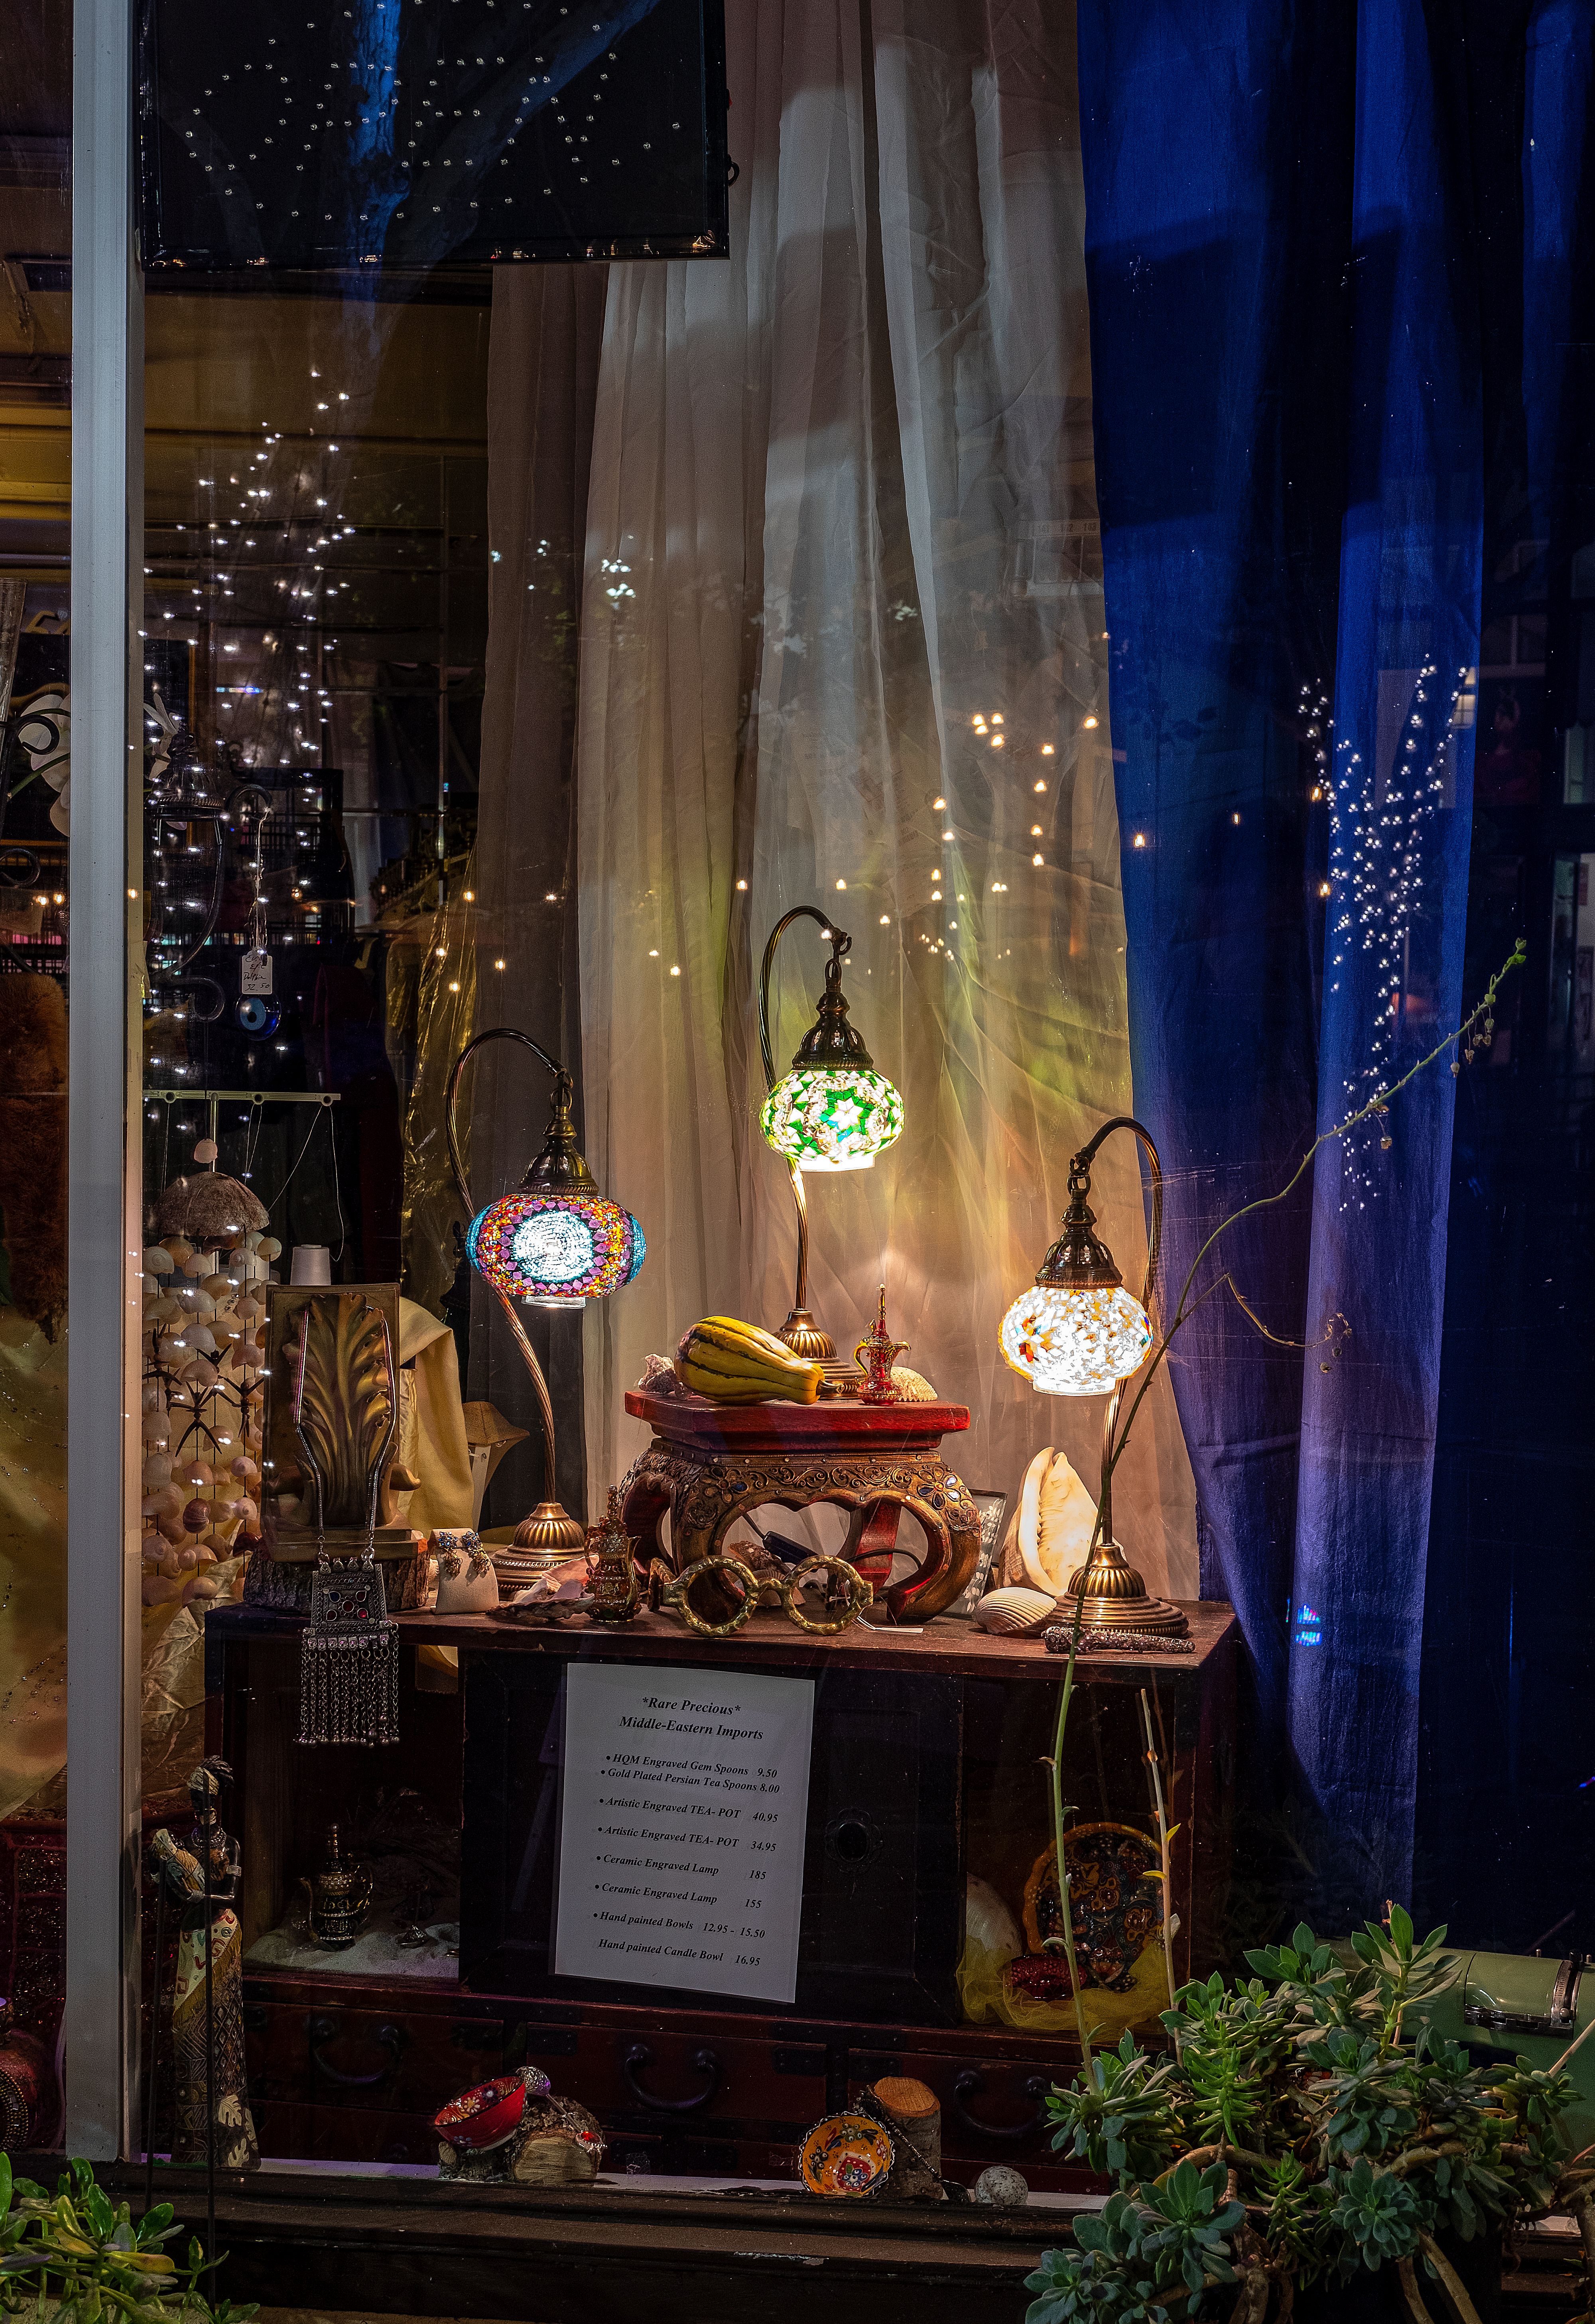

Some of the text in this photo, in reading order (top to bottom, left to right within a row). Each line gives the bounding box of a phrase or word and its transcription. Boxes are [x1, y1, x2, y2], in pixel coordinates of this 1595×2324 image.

[619, 1716, 763, 1740] Middle-Eastern Imports
[612, 1754, 777, 1778] HQM Engraved Gem Spoons 9.50
[608, 1768, 780, 1793] Gold Plated Persian Tea Spoons 8.00
[605, 1797, 640, 1808] Artistic
[642, 1800, 688, 1813] Engraved
[718, 1808, 741, 1818] POT
[752, 1812, 778, 1822] 40.95
[604, 1826, 638, 1837] Artistic
[640, 1829, 686, 1841] Engraved
[716, 1837, 740, 1847] POT
[750, 1841, 776, 1851] 34.95
[603, 1854, 766, 1880] Ceramic Engraved Lamp 185
[602, 1883, 762, 1908] Ceramic Engraved Lamp 155
[600, 1911, 627, 1922] Hand
[627, 1916, 664, 1926] painted
[665, 1918, 693, 1929] Bowls
[703, 1923, 728, 1933] 12.95
[740, 1927, 765, 1938] 15.50
[598, 1939, 760, 1966] Hand painted Candle Bowl 16.95
